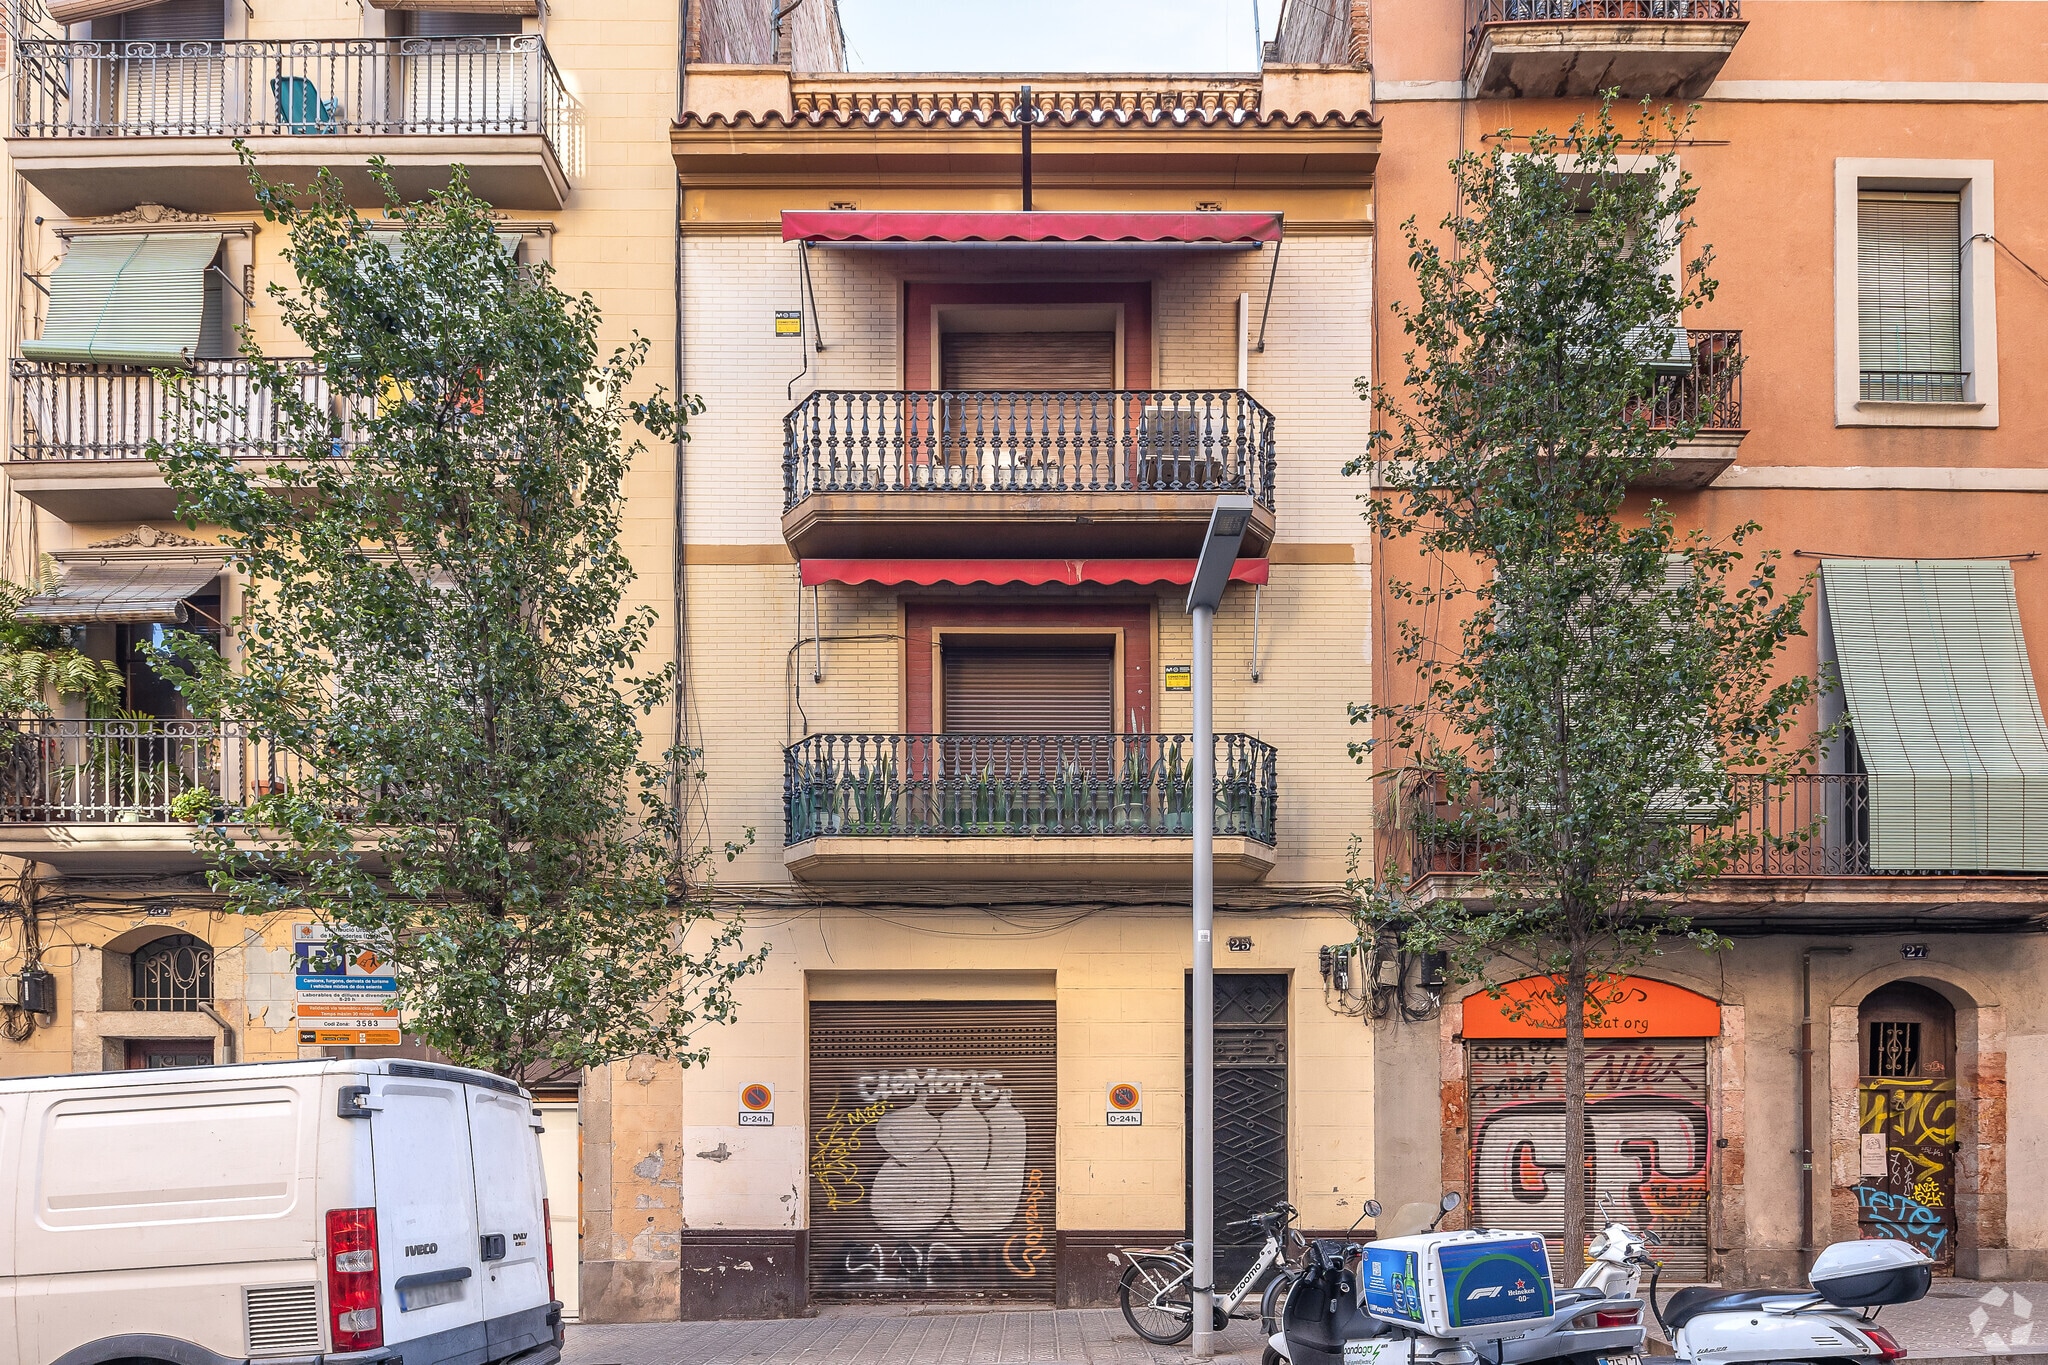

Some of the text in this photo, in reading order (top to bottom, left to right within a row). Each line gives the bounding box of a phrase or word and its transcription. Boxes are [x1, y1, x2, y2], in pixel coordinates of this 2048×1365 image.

[1231, 938, 1250, 951] 25
[1906, 945, 1923, 957] 27
[405, 1243, 438, 1257] IVECO
[1236, 1263, 1262, 1294] zoomo
[1507, 1287, 1535, 1297] Heineken
